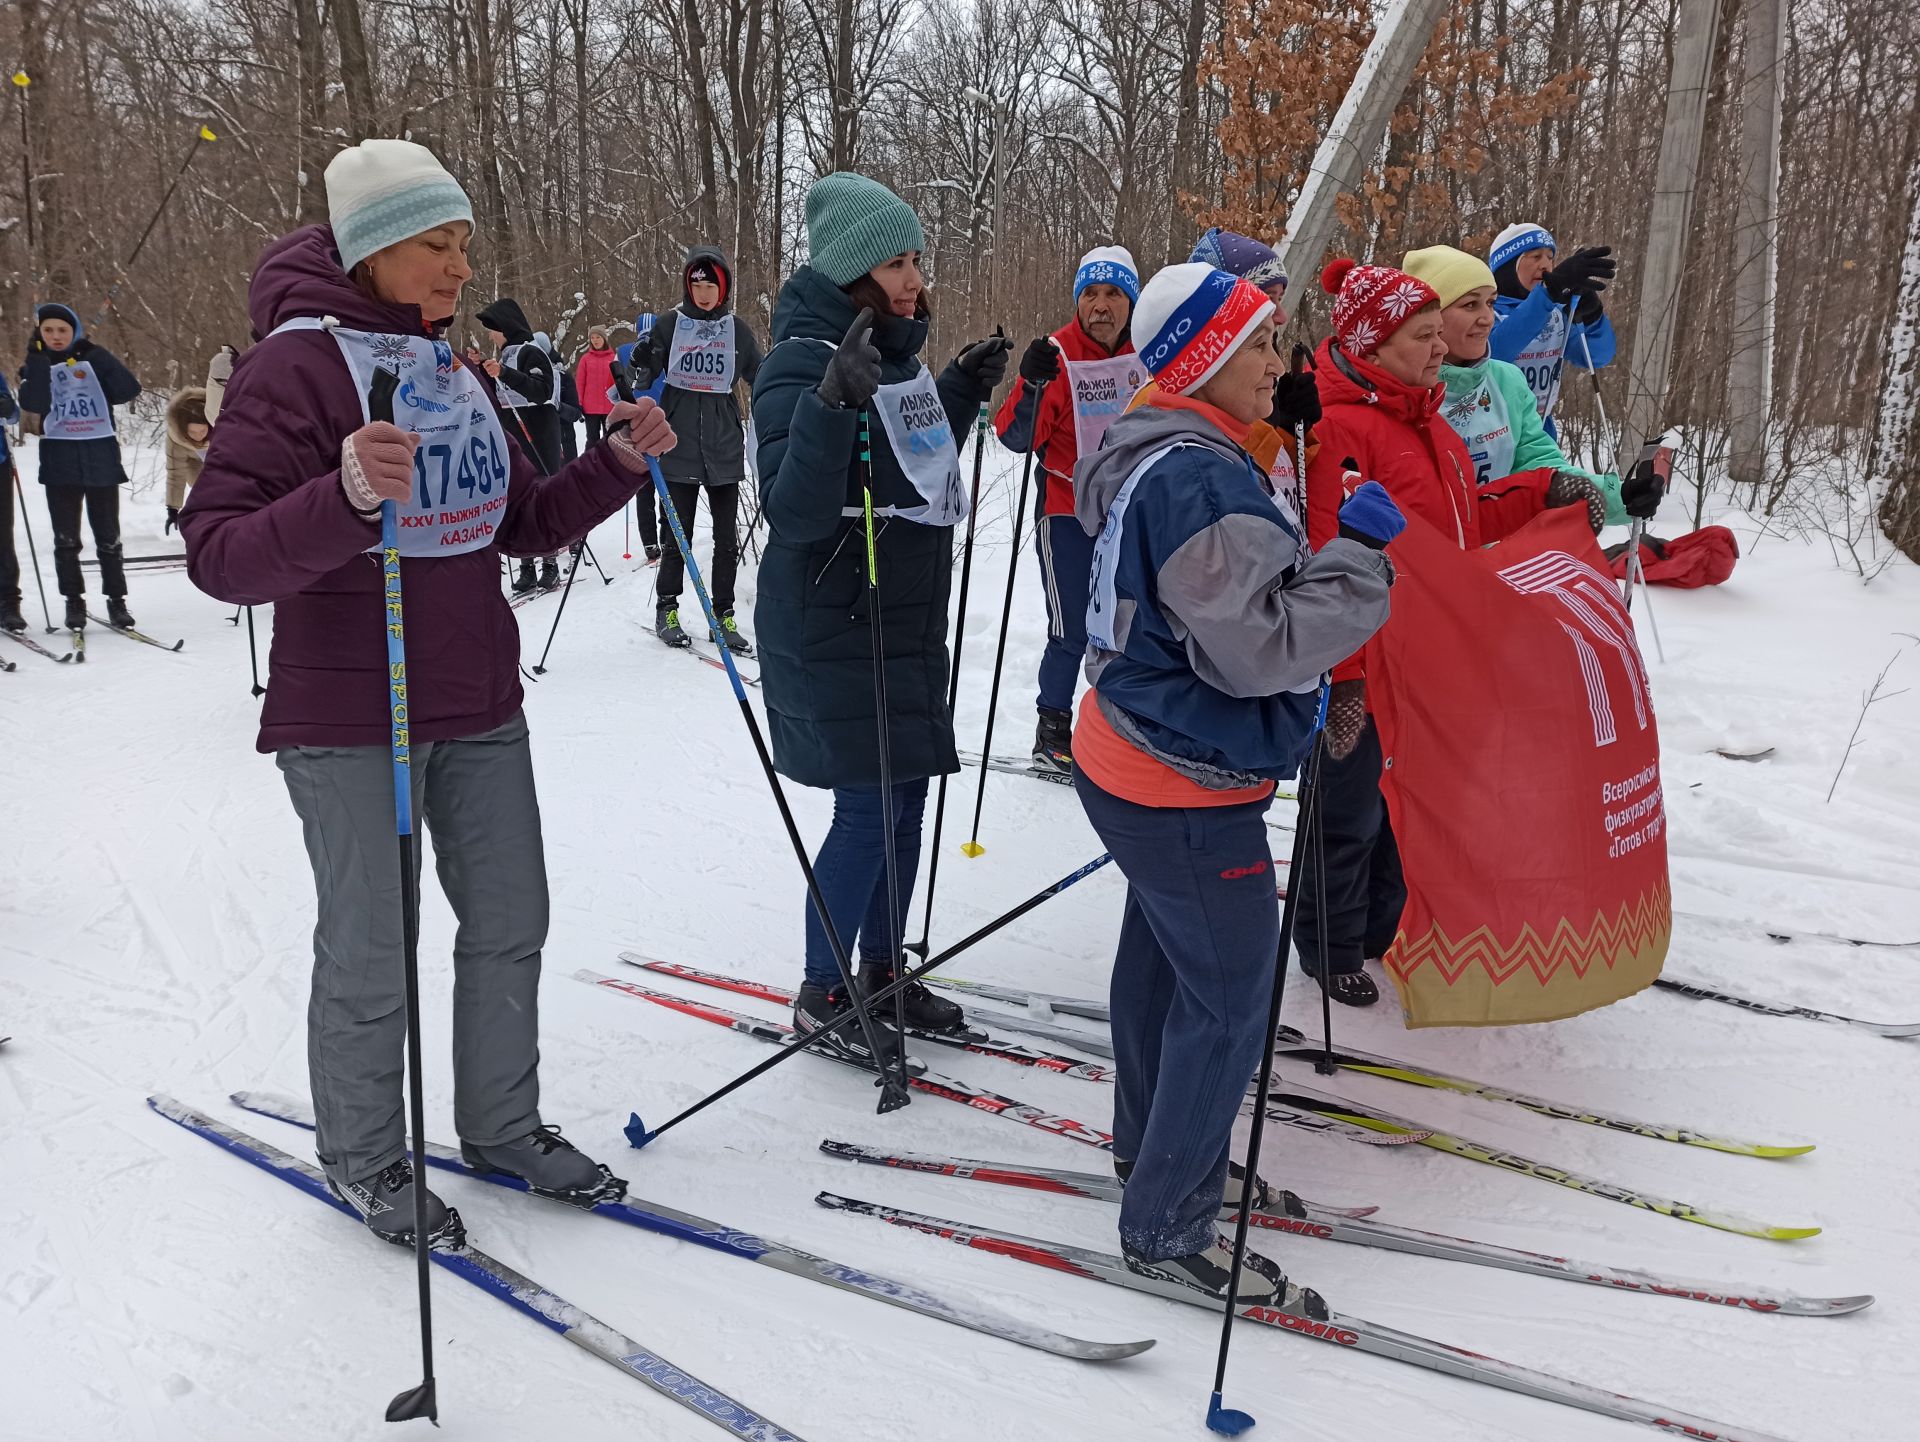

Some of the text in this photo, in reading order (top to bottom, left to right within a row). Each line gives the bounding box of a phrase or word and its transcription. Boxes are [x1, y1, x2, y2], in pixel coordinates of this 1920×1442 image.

[1493, 235, 1534, 266] ЛЫЖНЯ
[1146, 317, 1192, 368] 2010
[680, 352, 725, 375] 19035
[1077, 378, 1116, 390] ЛЫЖНЯ
[1078, 390, 1118, 402] РОССИИ
[54, 398, 99, 421] 17481
[413, 430, 506, 509] 17464
[439, 504, 480, 526] ЛЫЖНЯ
[440, 521, 494, 546] КАЗАНЬ
[385, 547, 411, 768] KLIFF SPORT
[1609, 832, 1642, 859] «Готов
[909, 1078, 969, 1103] LASSIC
[1241, 1305, 1360, 1345] ATOMIC
